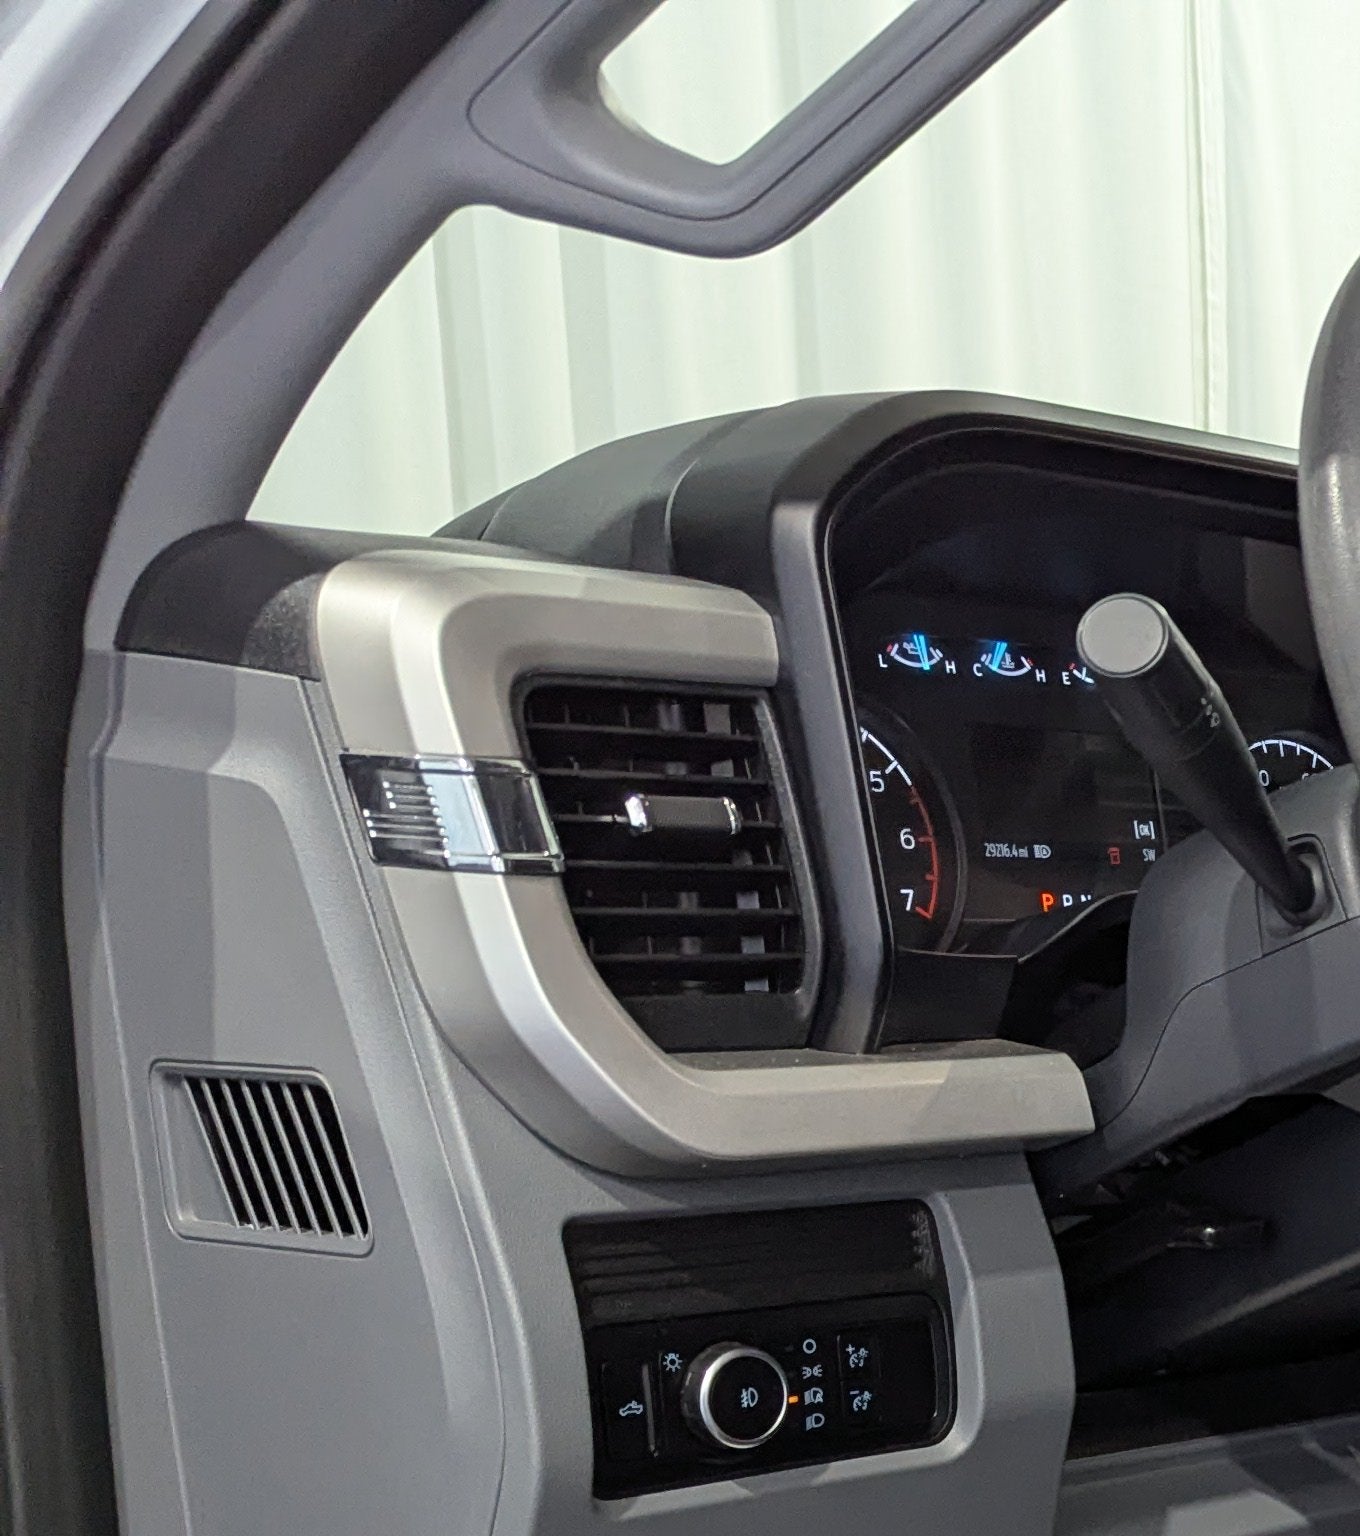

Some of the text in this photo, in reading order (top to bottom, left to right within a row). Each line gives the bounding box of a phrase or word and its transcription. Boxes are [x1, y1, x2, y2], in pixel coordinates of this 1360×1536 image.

[877, 653, 888, 668] L
[945, 660, 956, 675] H
[973, 663, 983, 677] C
[1035, 669, 1046, 683] H
[1062, 671, 1071, 686] E
[869, 770, 885, 793] 5
[899, 828, 915, 850] 6
[1142, 848, 1156, 862] SW
[899, 888, 914, 912] 7
[1041, 893, 1054, 912] P
